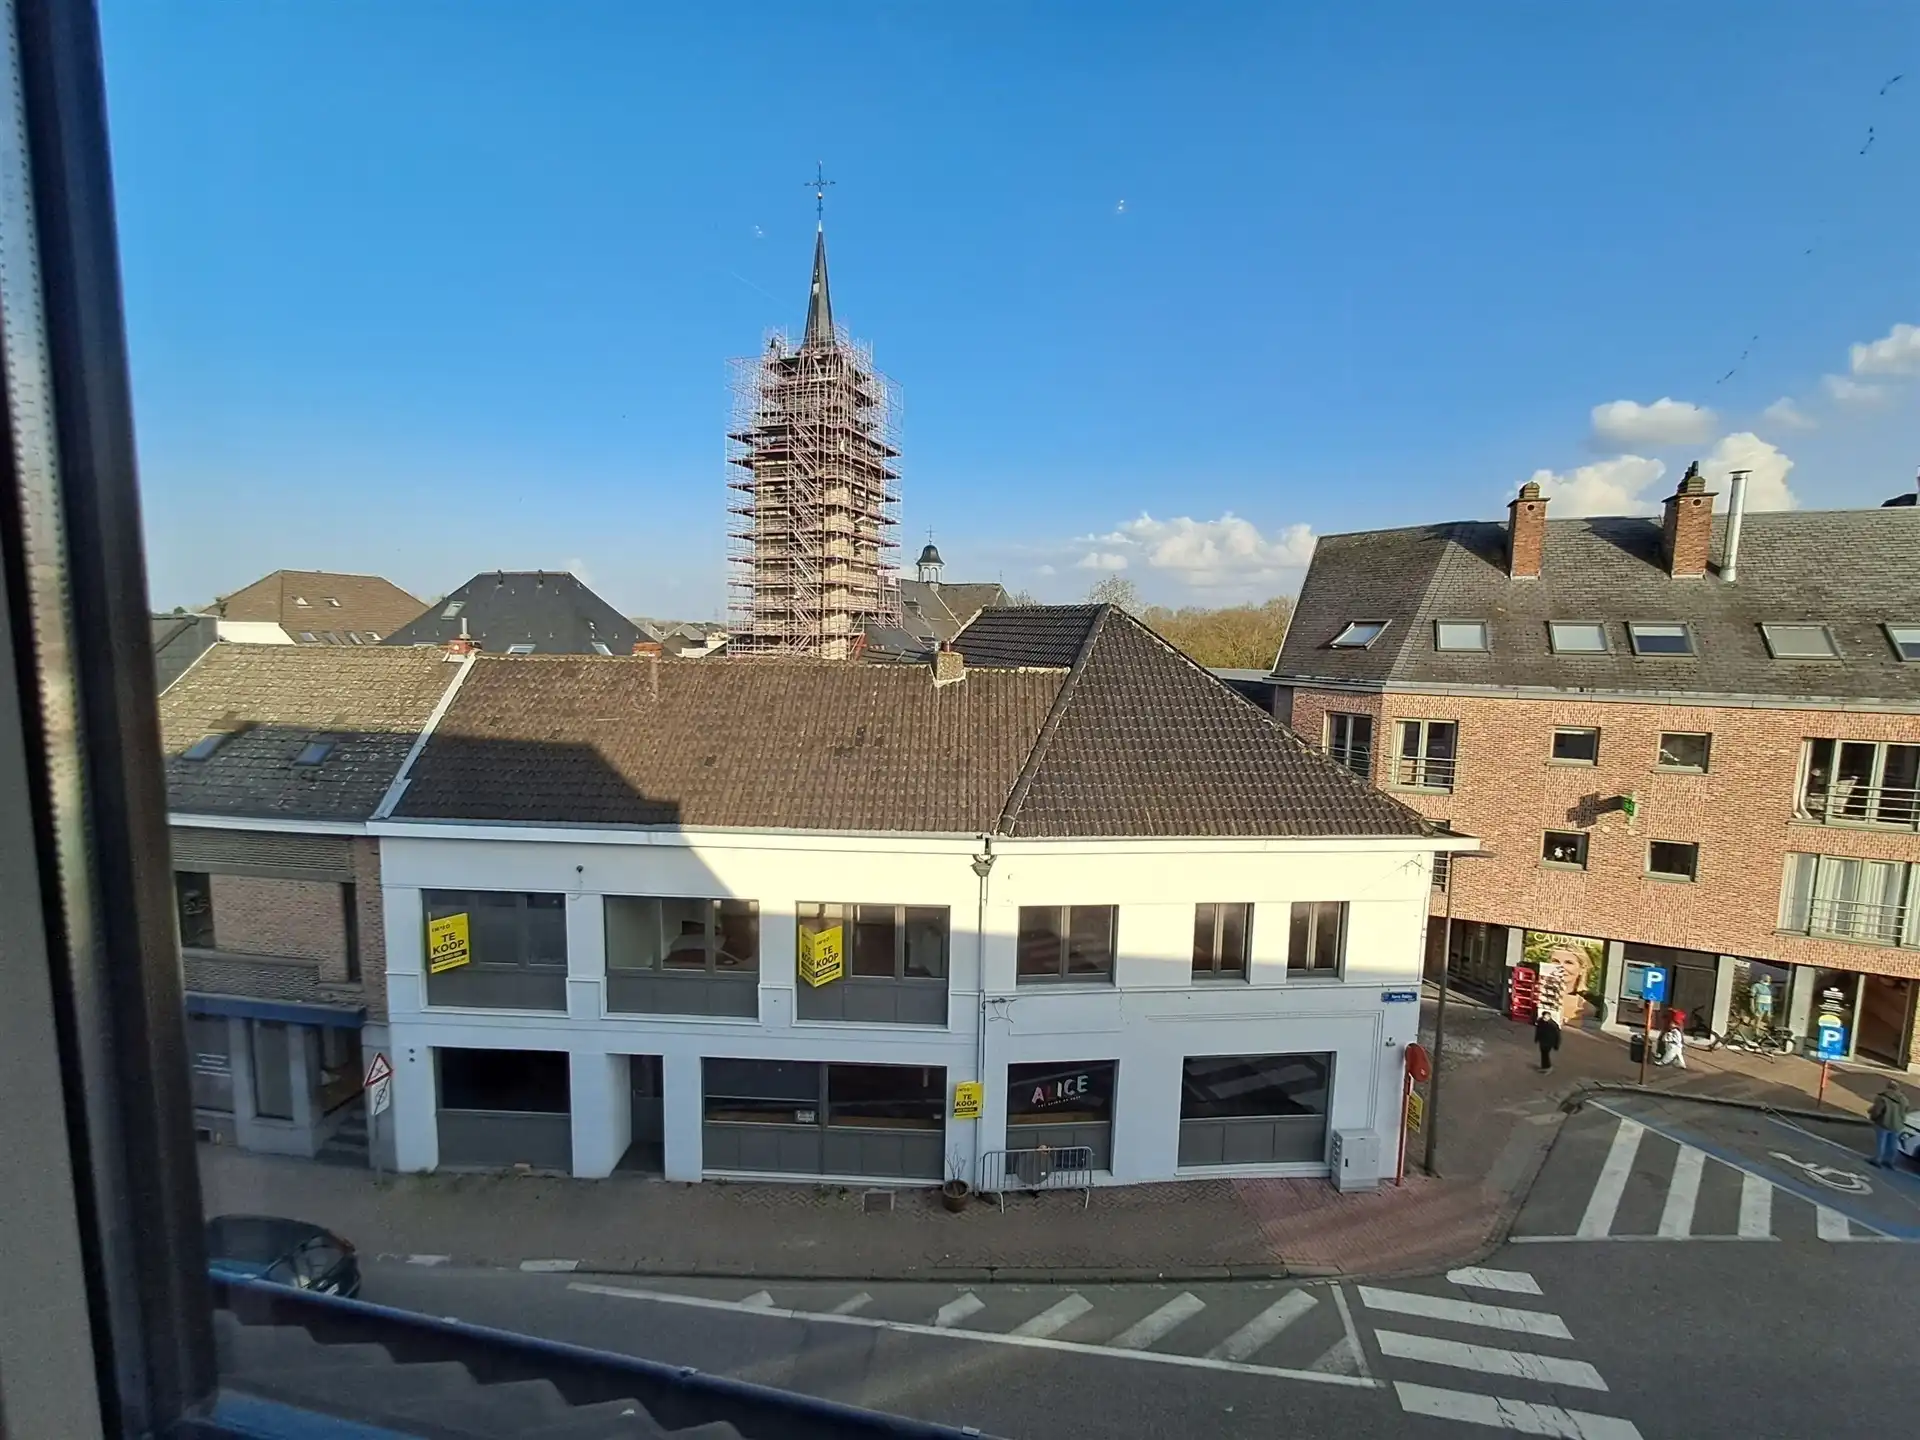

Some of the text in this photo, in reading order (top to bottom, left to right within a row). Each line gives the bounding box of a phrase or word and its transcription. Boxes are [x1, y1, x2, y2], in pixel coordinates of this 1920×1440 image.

[441, 931, 456, 942] TE
[1534, 932, 1594, 948] CAUDALIE
[433, 939, 465, 955] KOOP
[823, 945, 833, 956] TE
[816, 952, 839, 968] KOOP
[1646, 971, 1663, 988] P
[1822, 1029, 1841, 1048] P
